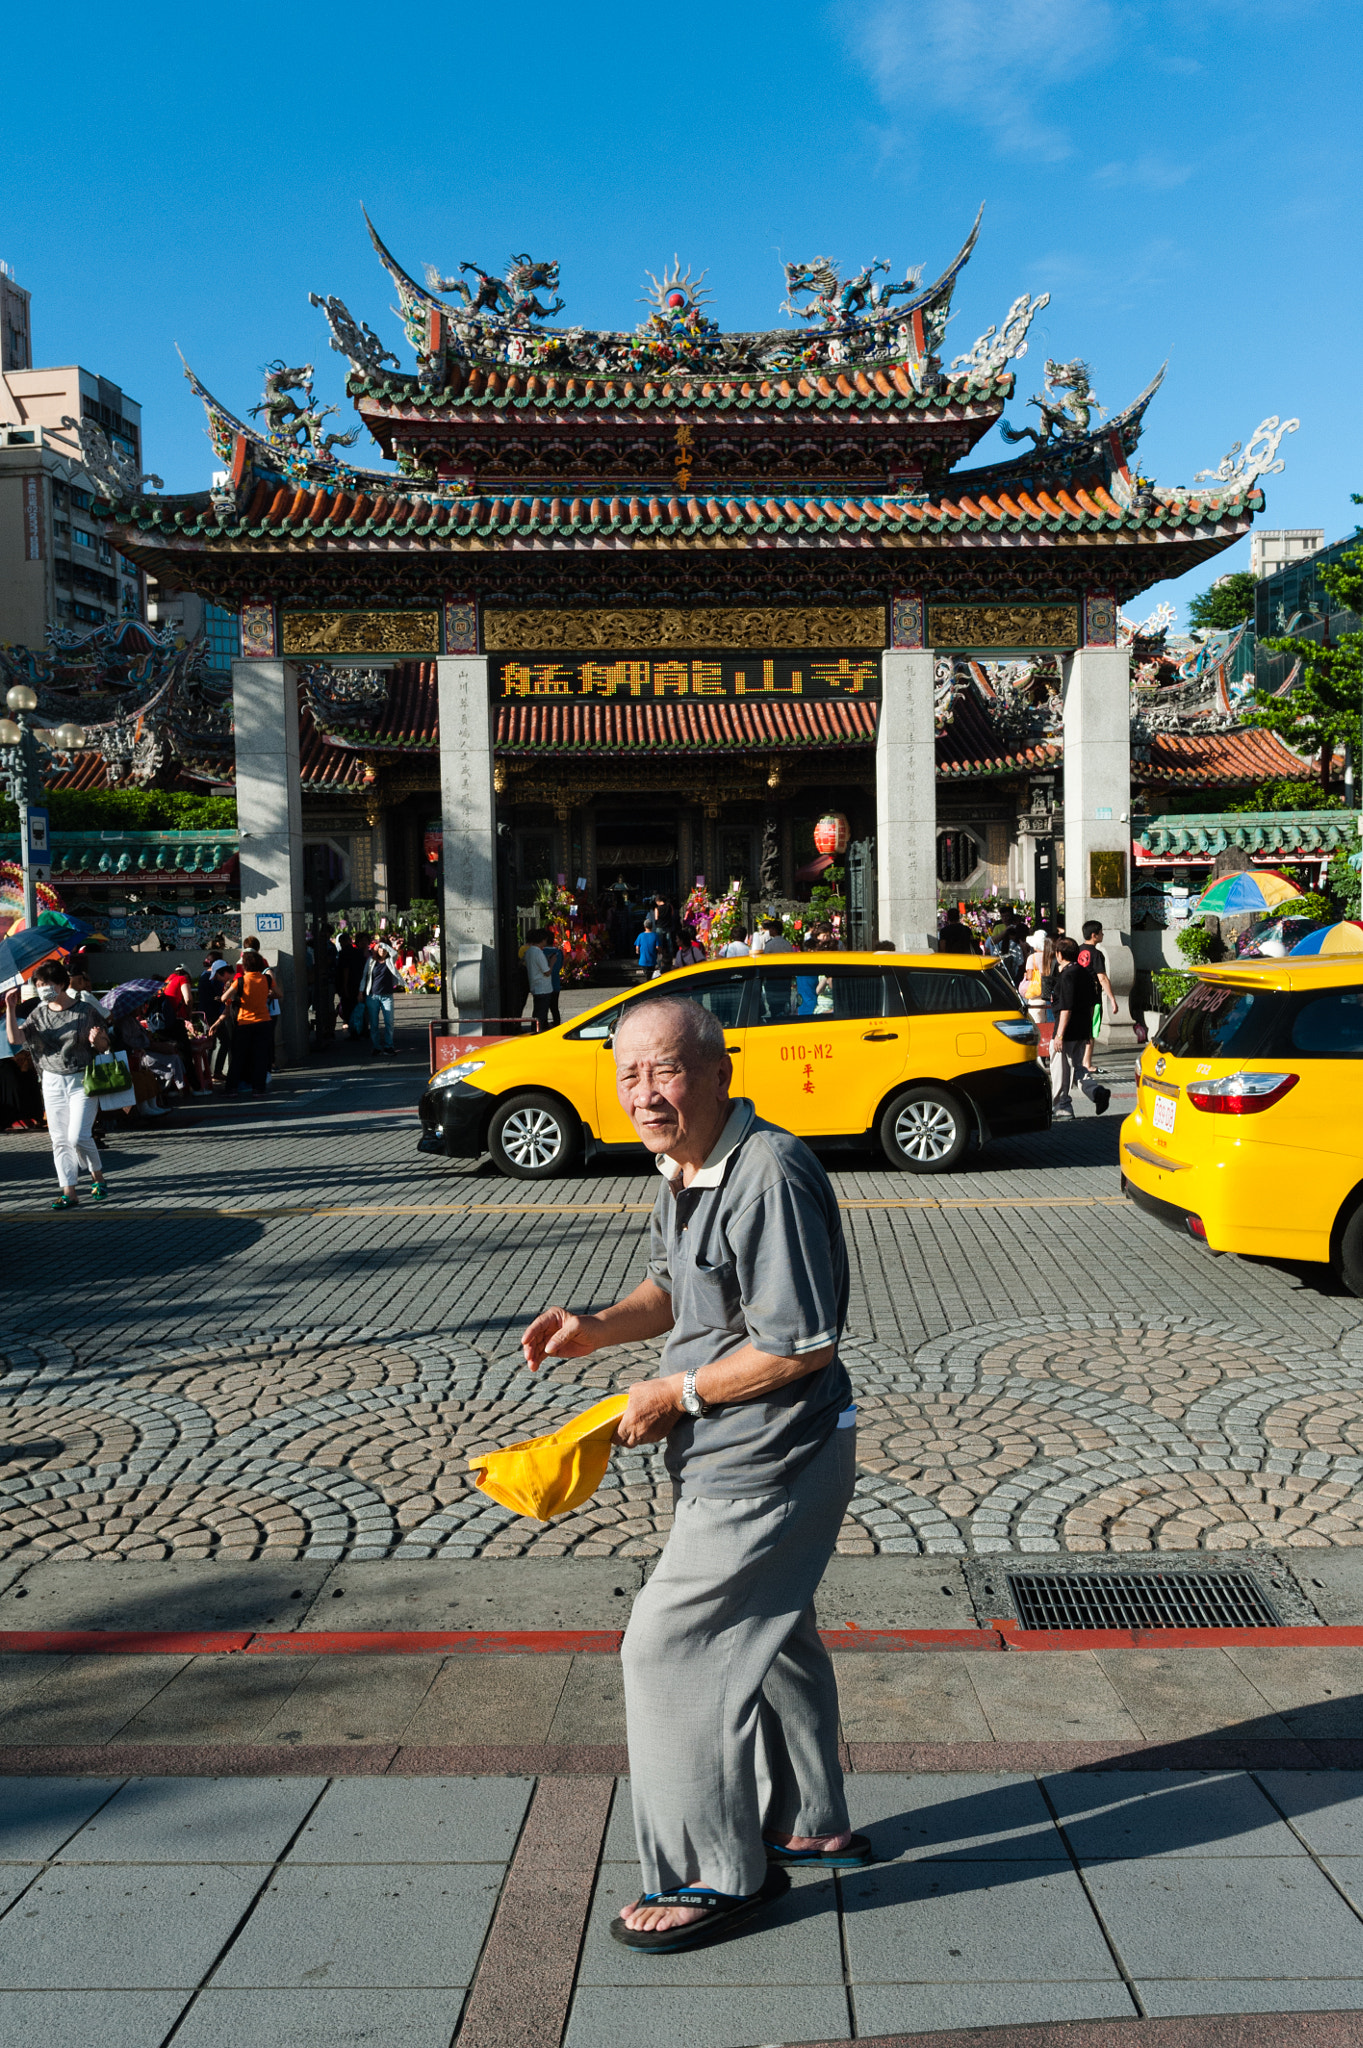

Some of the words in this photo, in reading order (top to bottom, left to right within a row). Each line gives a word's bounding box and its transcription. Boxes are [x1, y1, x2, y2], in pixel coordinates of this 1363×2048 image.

[672, 424, 696, 492] 龍山寺
[500, 659, 879, 698] 艋舺龍山寺
[259, 920, 279, 930] 211
[780, 1043, 833, 1061] 010-M2
[802, 1063, 816, 1094] 平安
